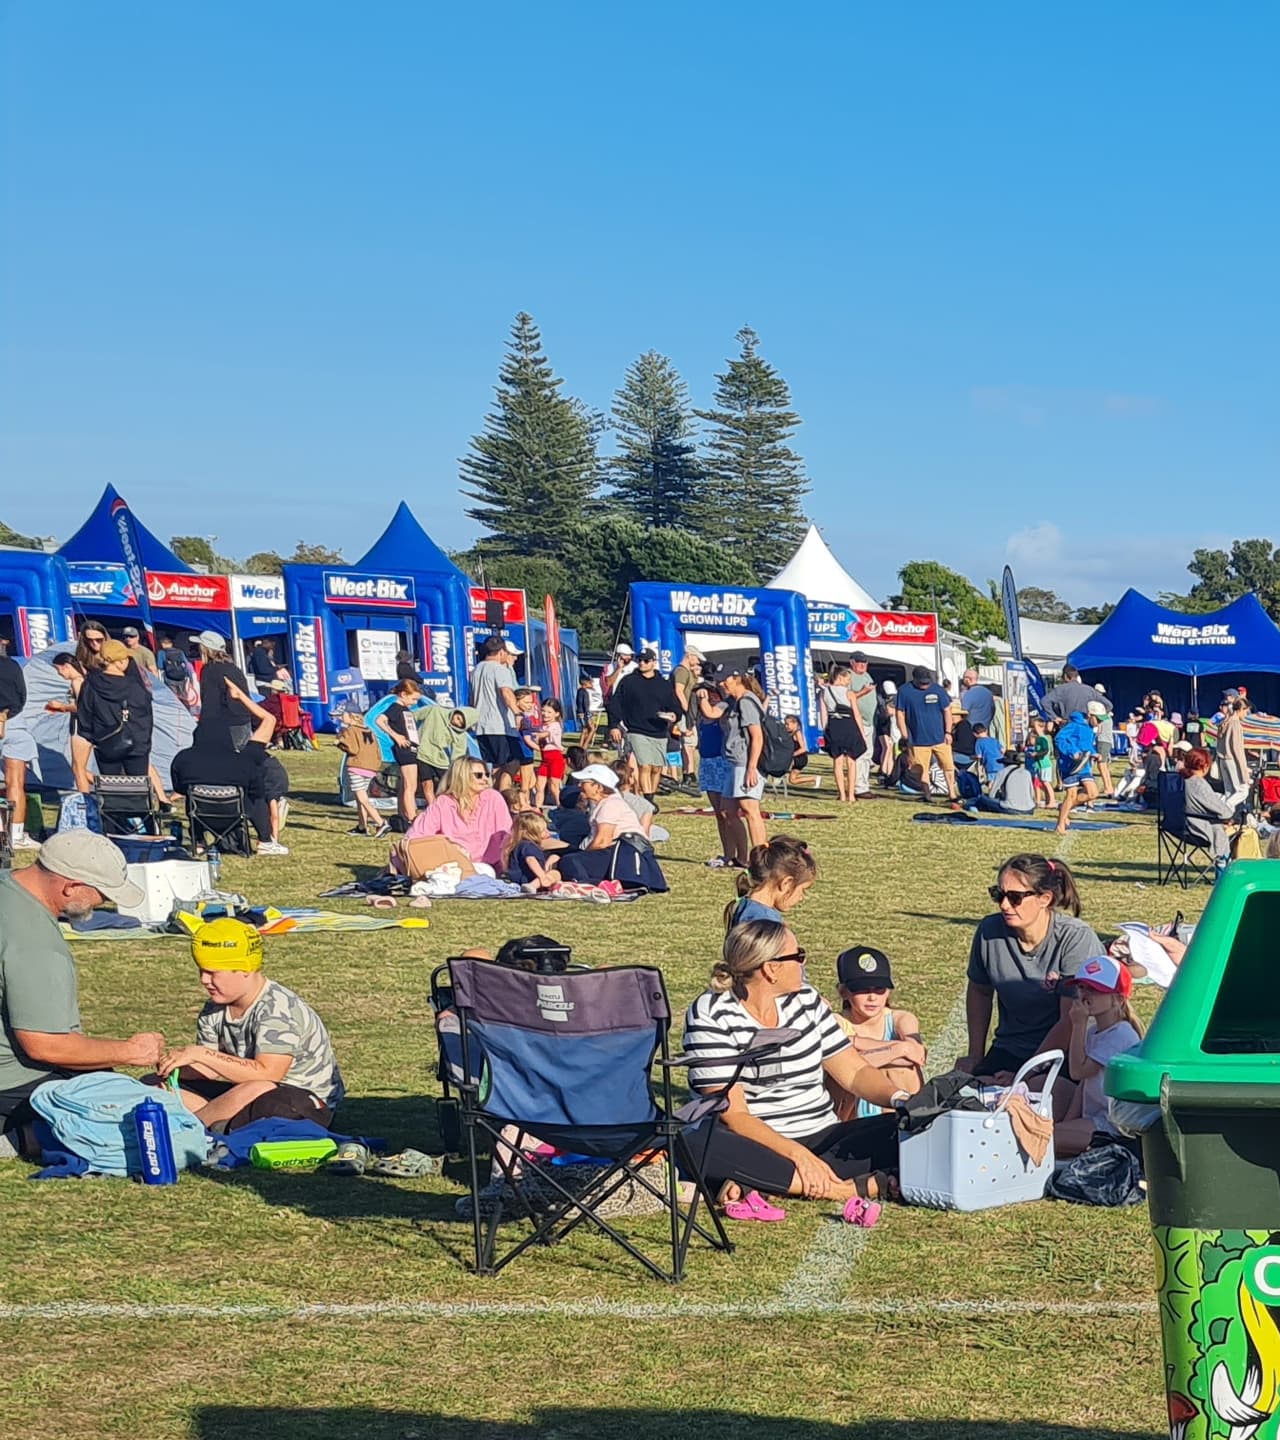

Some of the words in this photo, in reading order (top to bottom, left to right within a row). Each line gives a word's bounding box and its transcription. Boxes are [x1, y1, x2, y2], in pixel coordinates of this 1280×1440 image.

[168, 583, 218, 598] Anchor
[329, 576, 408, 599] Weet-Bix
[670, 591, 757, 616] Weet-Bix
[680, 613, 724, 625] GROWN
[725, 615, 748, 627] UPS
[823, 612, 845, 622] FOR
[814, 623, 836, 633] UPS
[882, 619, 929, 634] Anchor
[1157, 623, 1230, 638] Weet-Bix
[296, 622, 320, 698] Weet-Bix
[775, 645, 801, 724] Weet-Bi
